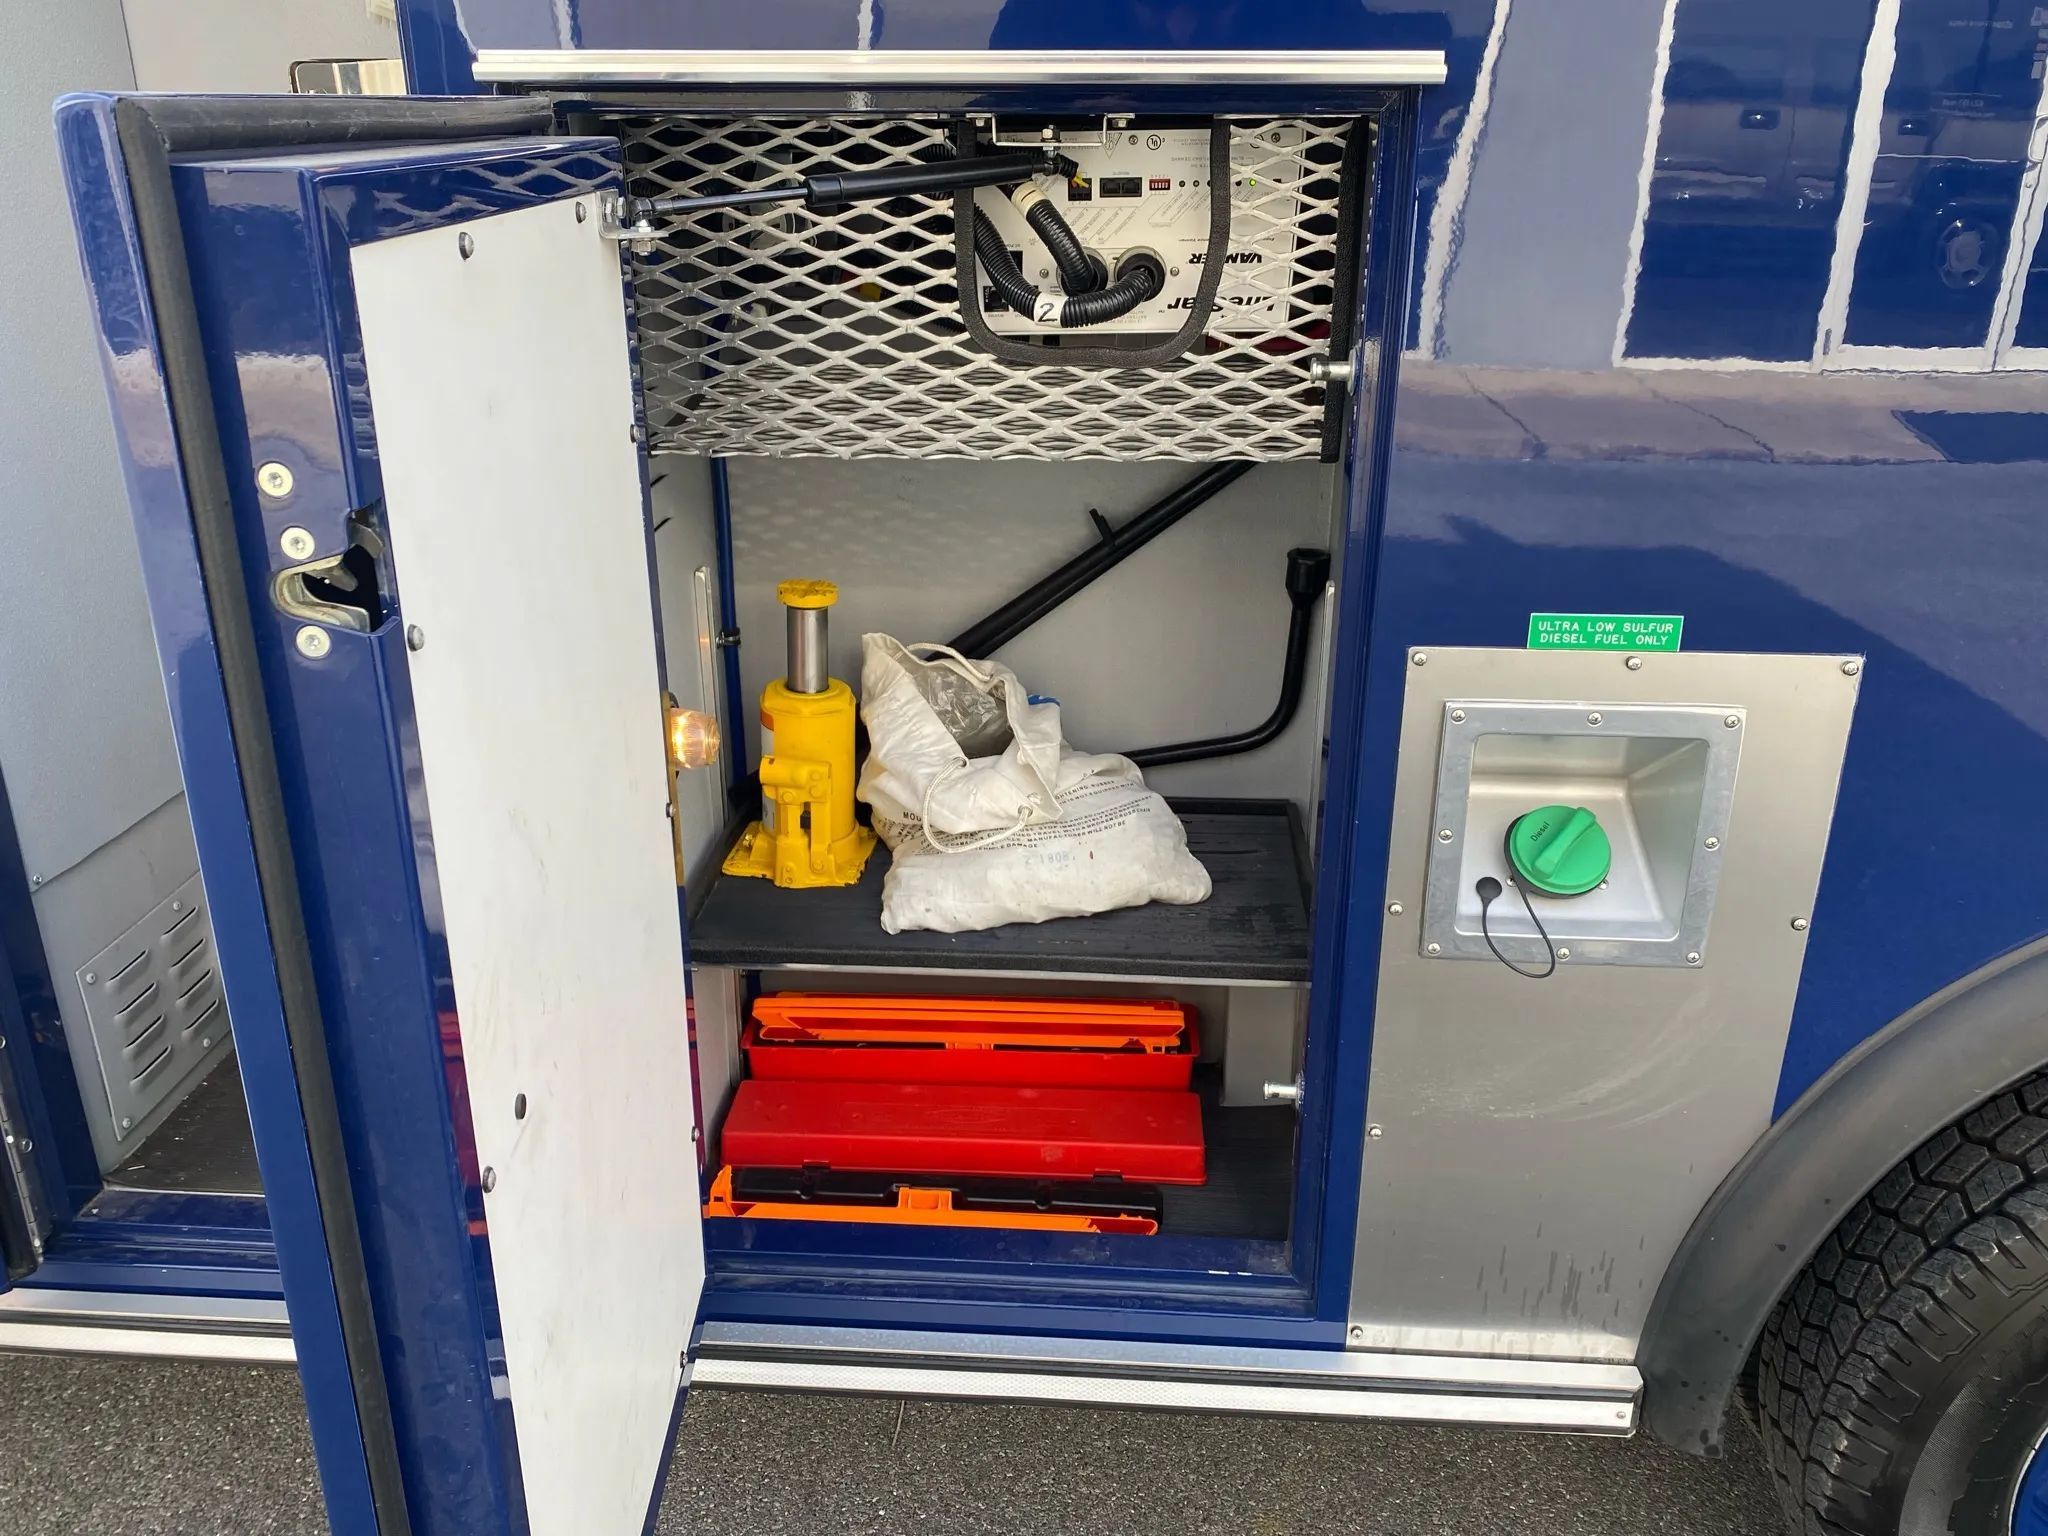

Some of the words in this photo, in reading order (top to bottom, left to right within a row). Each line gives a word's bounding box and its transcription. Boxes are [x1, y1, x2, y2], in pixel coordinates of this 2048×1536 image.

[1188, 253, 1262, 264] VANER
[1037, 301, 1059, 324] 2
[1538, 621, 1580, 632] ULTRA
[1587, 622, 1616, 632] LOW
[1622, 622, 1674, 634] SULFUR
[1540, 633, 1587, 644] DIESEL
[1594, 634, 1628, 645] FUEL
[1635, 635, 1669, 646] ONLY
[1530, 821, 1550, 842] Diesel
